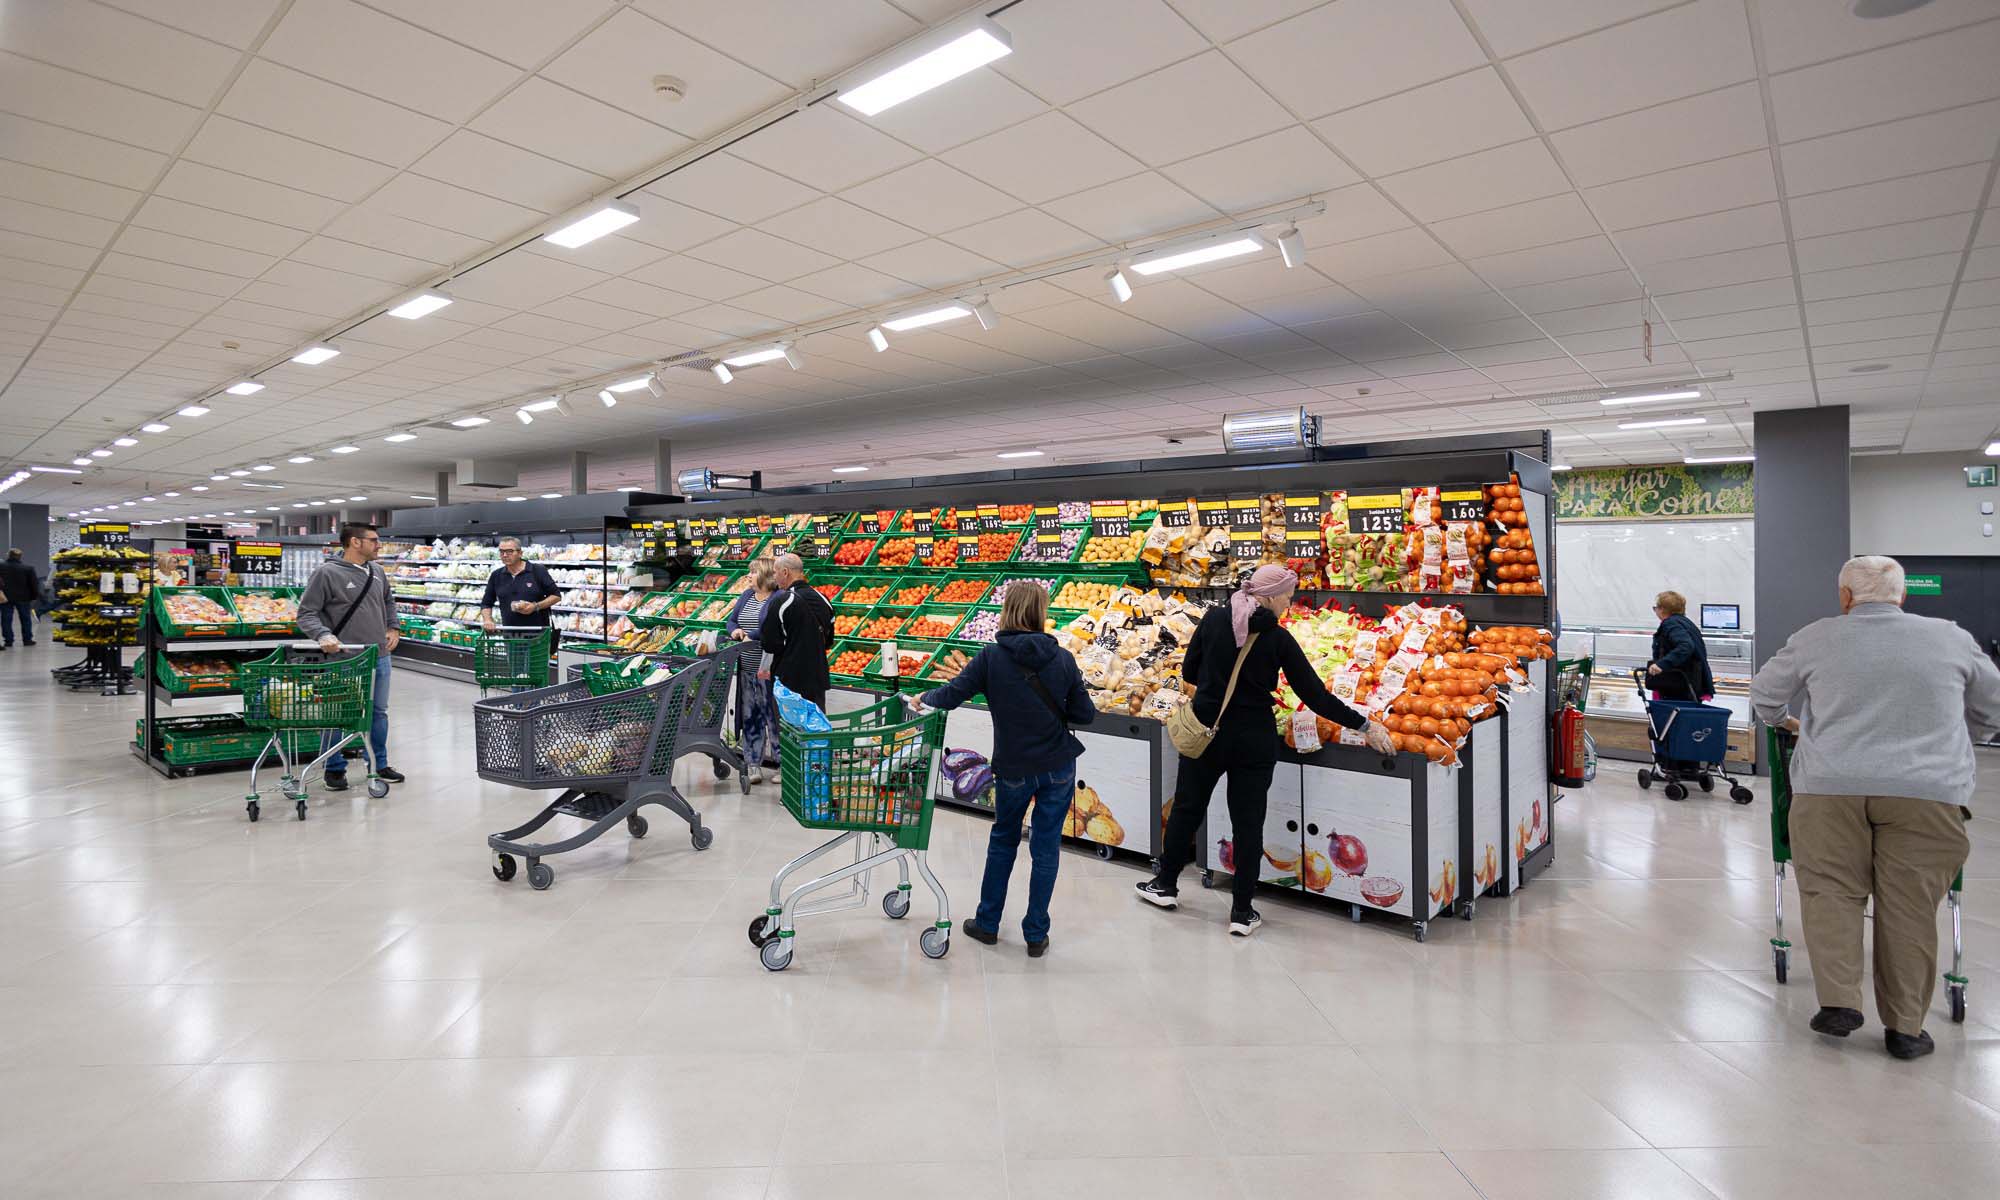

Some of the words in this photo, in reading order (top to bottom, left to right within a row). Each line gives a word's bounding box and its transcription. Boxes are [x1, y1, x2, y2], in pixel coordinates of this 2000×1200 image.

[1559, 498, 1625, 514] PARA
[1635, 486, 1755, 517] Comer
[1568, 469, 1671, 504] Menjar
